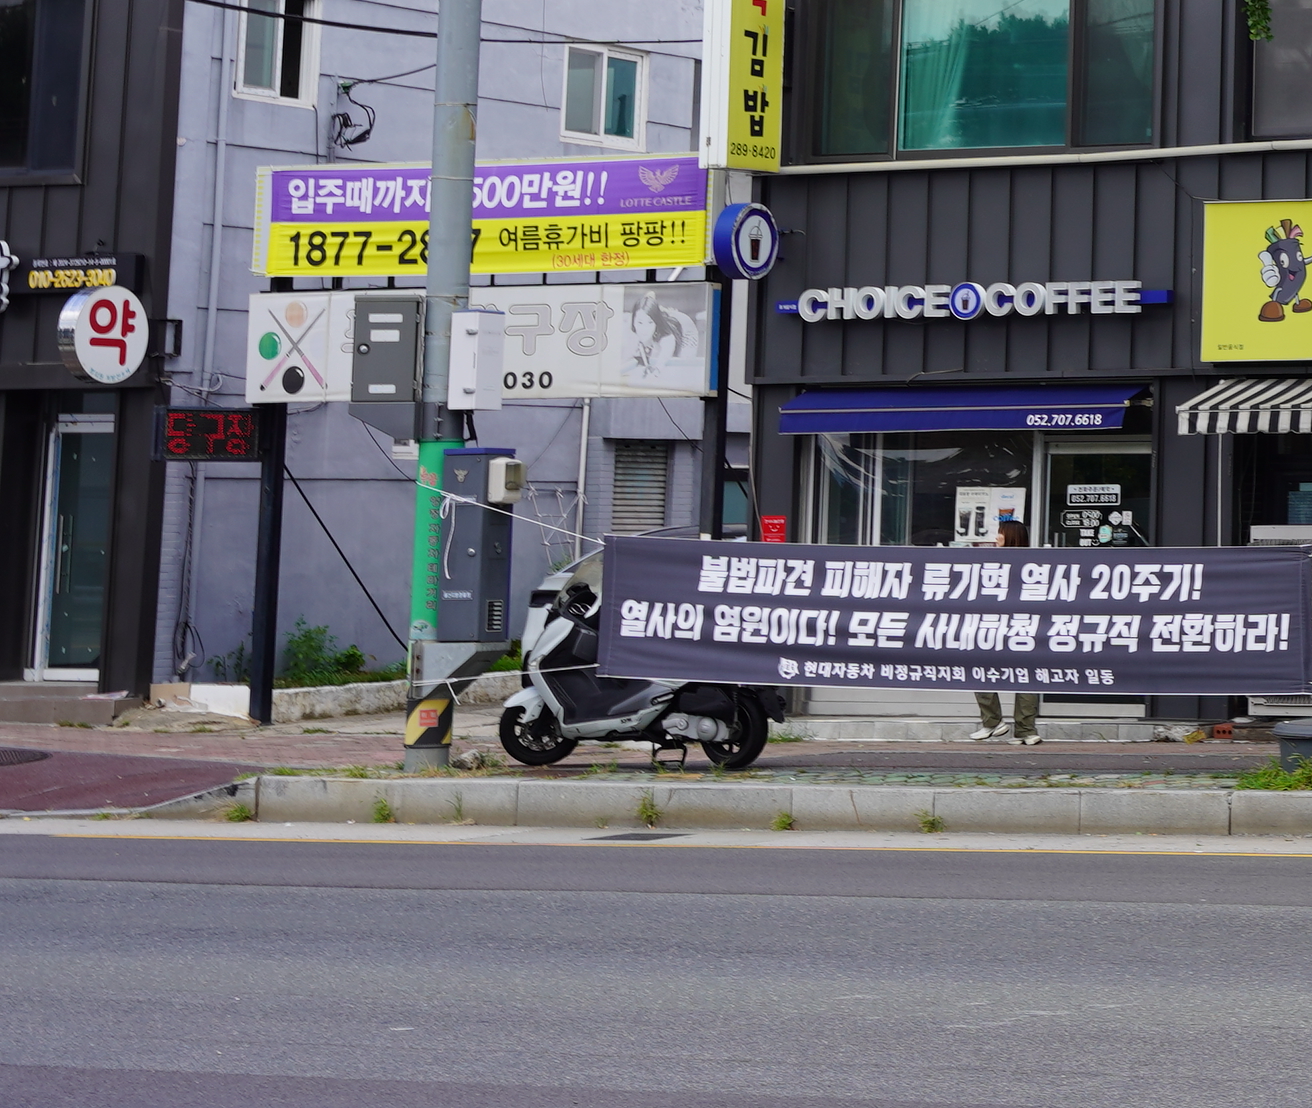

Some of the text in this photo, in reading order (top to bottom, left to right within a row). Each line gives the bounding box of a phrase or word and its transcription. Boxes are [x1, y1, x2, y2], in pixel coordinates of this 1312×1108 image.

[619, 195, 688, 208] LOTTE CASTLE
[289, 228, 482, 267] 1877-287
[498, 219, 687, 253] 여름휴가비 팡팡!!
[798, 280, 1143, 323] CHOICE COFFEE
[89, 298, 137, 366] 약
[1026, 413, 1103, 426] 052.707.6618
[698, 555, 1204, 602] 불법파견 피해자 류기혁 열사 20주기!
[620, 599, 1291, 653] 열사의 염원이다! 모든 사내하청 정규직 전환하라!
[804, 661, 1115, 685] 현대자동차 비정규직지회 이수기업 해고자 일동
